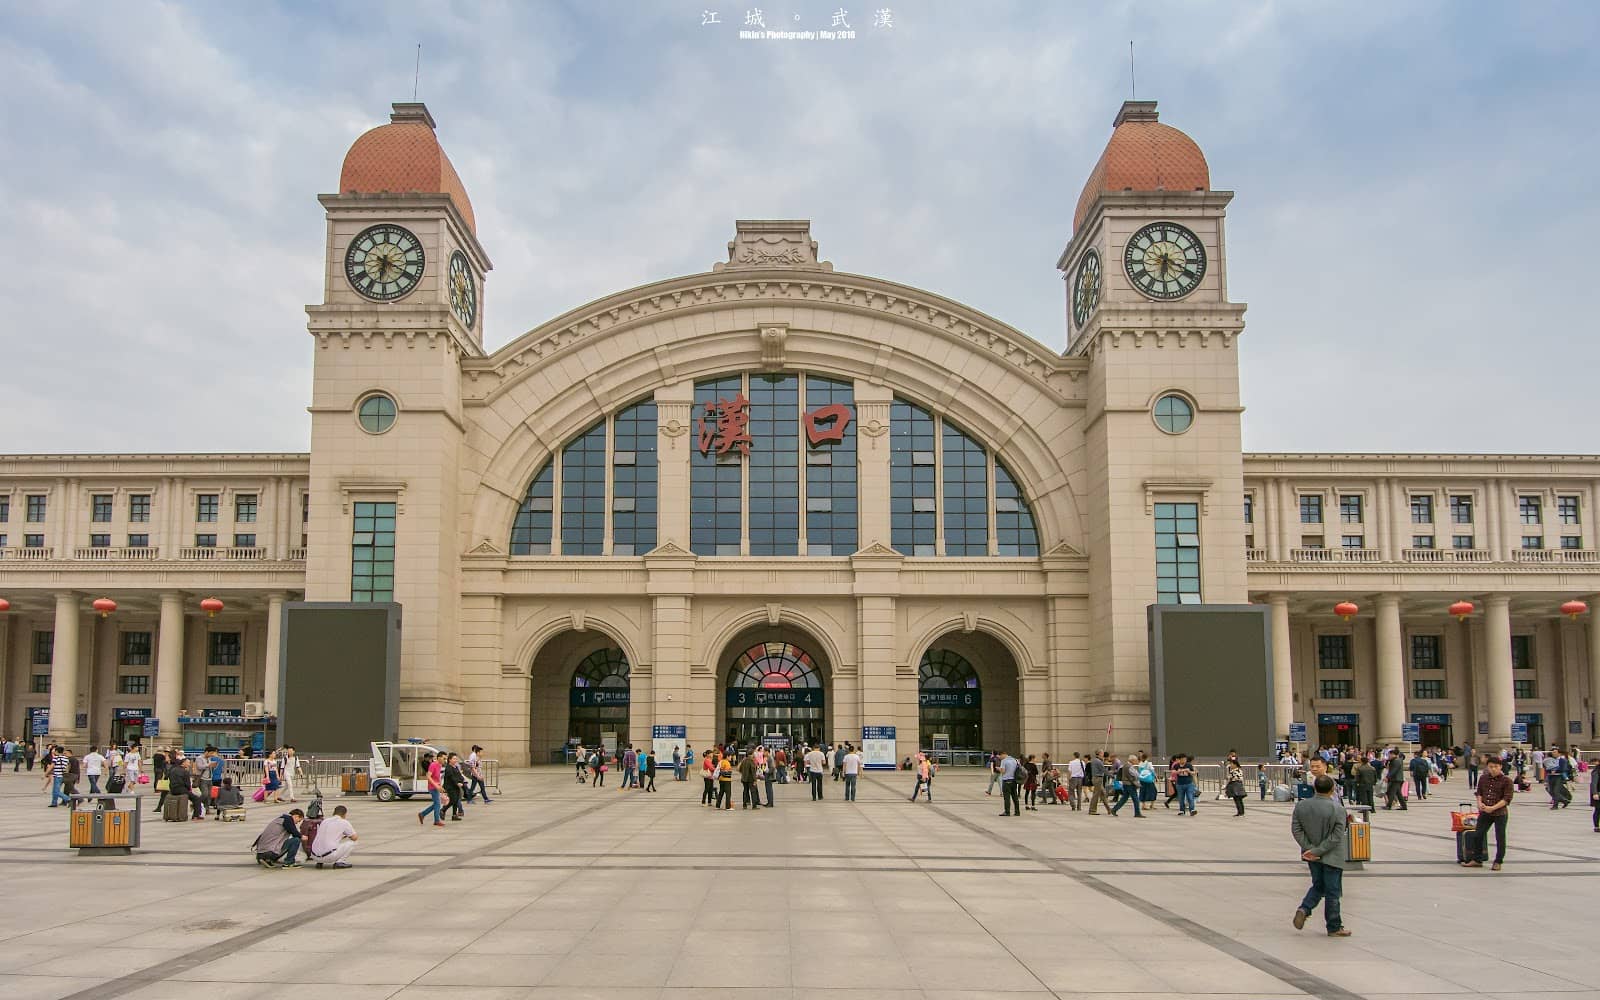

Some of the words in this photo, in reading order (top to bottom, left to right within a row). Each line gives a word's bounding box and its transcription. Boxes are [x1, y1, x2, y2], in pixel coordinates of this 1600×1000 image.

[738, 692, 746, 704] 3
[804, 693, 811, 703] 4
[964, 693, 972, 704] 6
